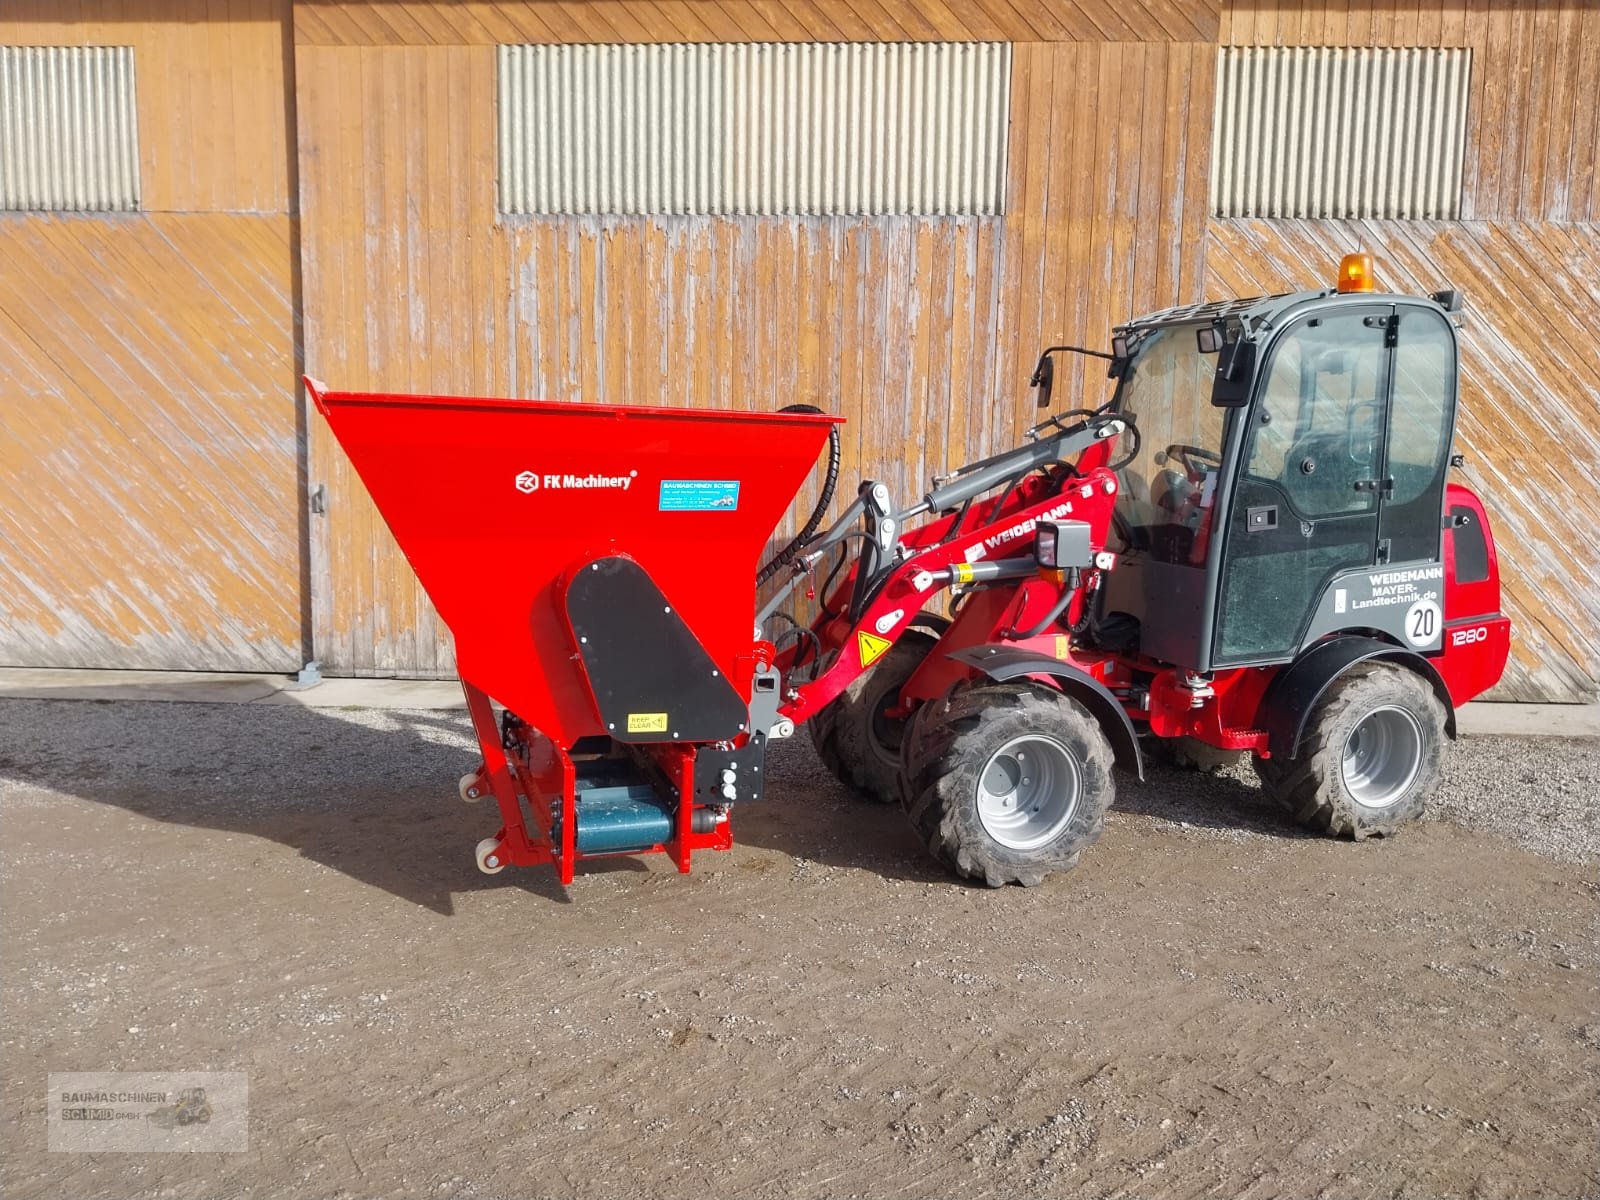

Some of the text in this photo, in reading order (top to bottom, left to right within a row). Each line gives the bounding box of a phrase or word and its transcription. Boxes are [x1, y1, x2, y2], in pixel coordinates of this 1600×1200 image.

[543, 475, 561, 489] FK
[1369, 567, 1443, 586] WEIDEMANN
[1372, 584, 1418, 597] MAYER-
[1352, 591, 1437, 609] Landtechnik.de
[1413, 608, 1434, 638] 20
[1452, 627, 1488, 646] 1280
